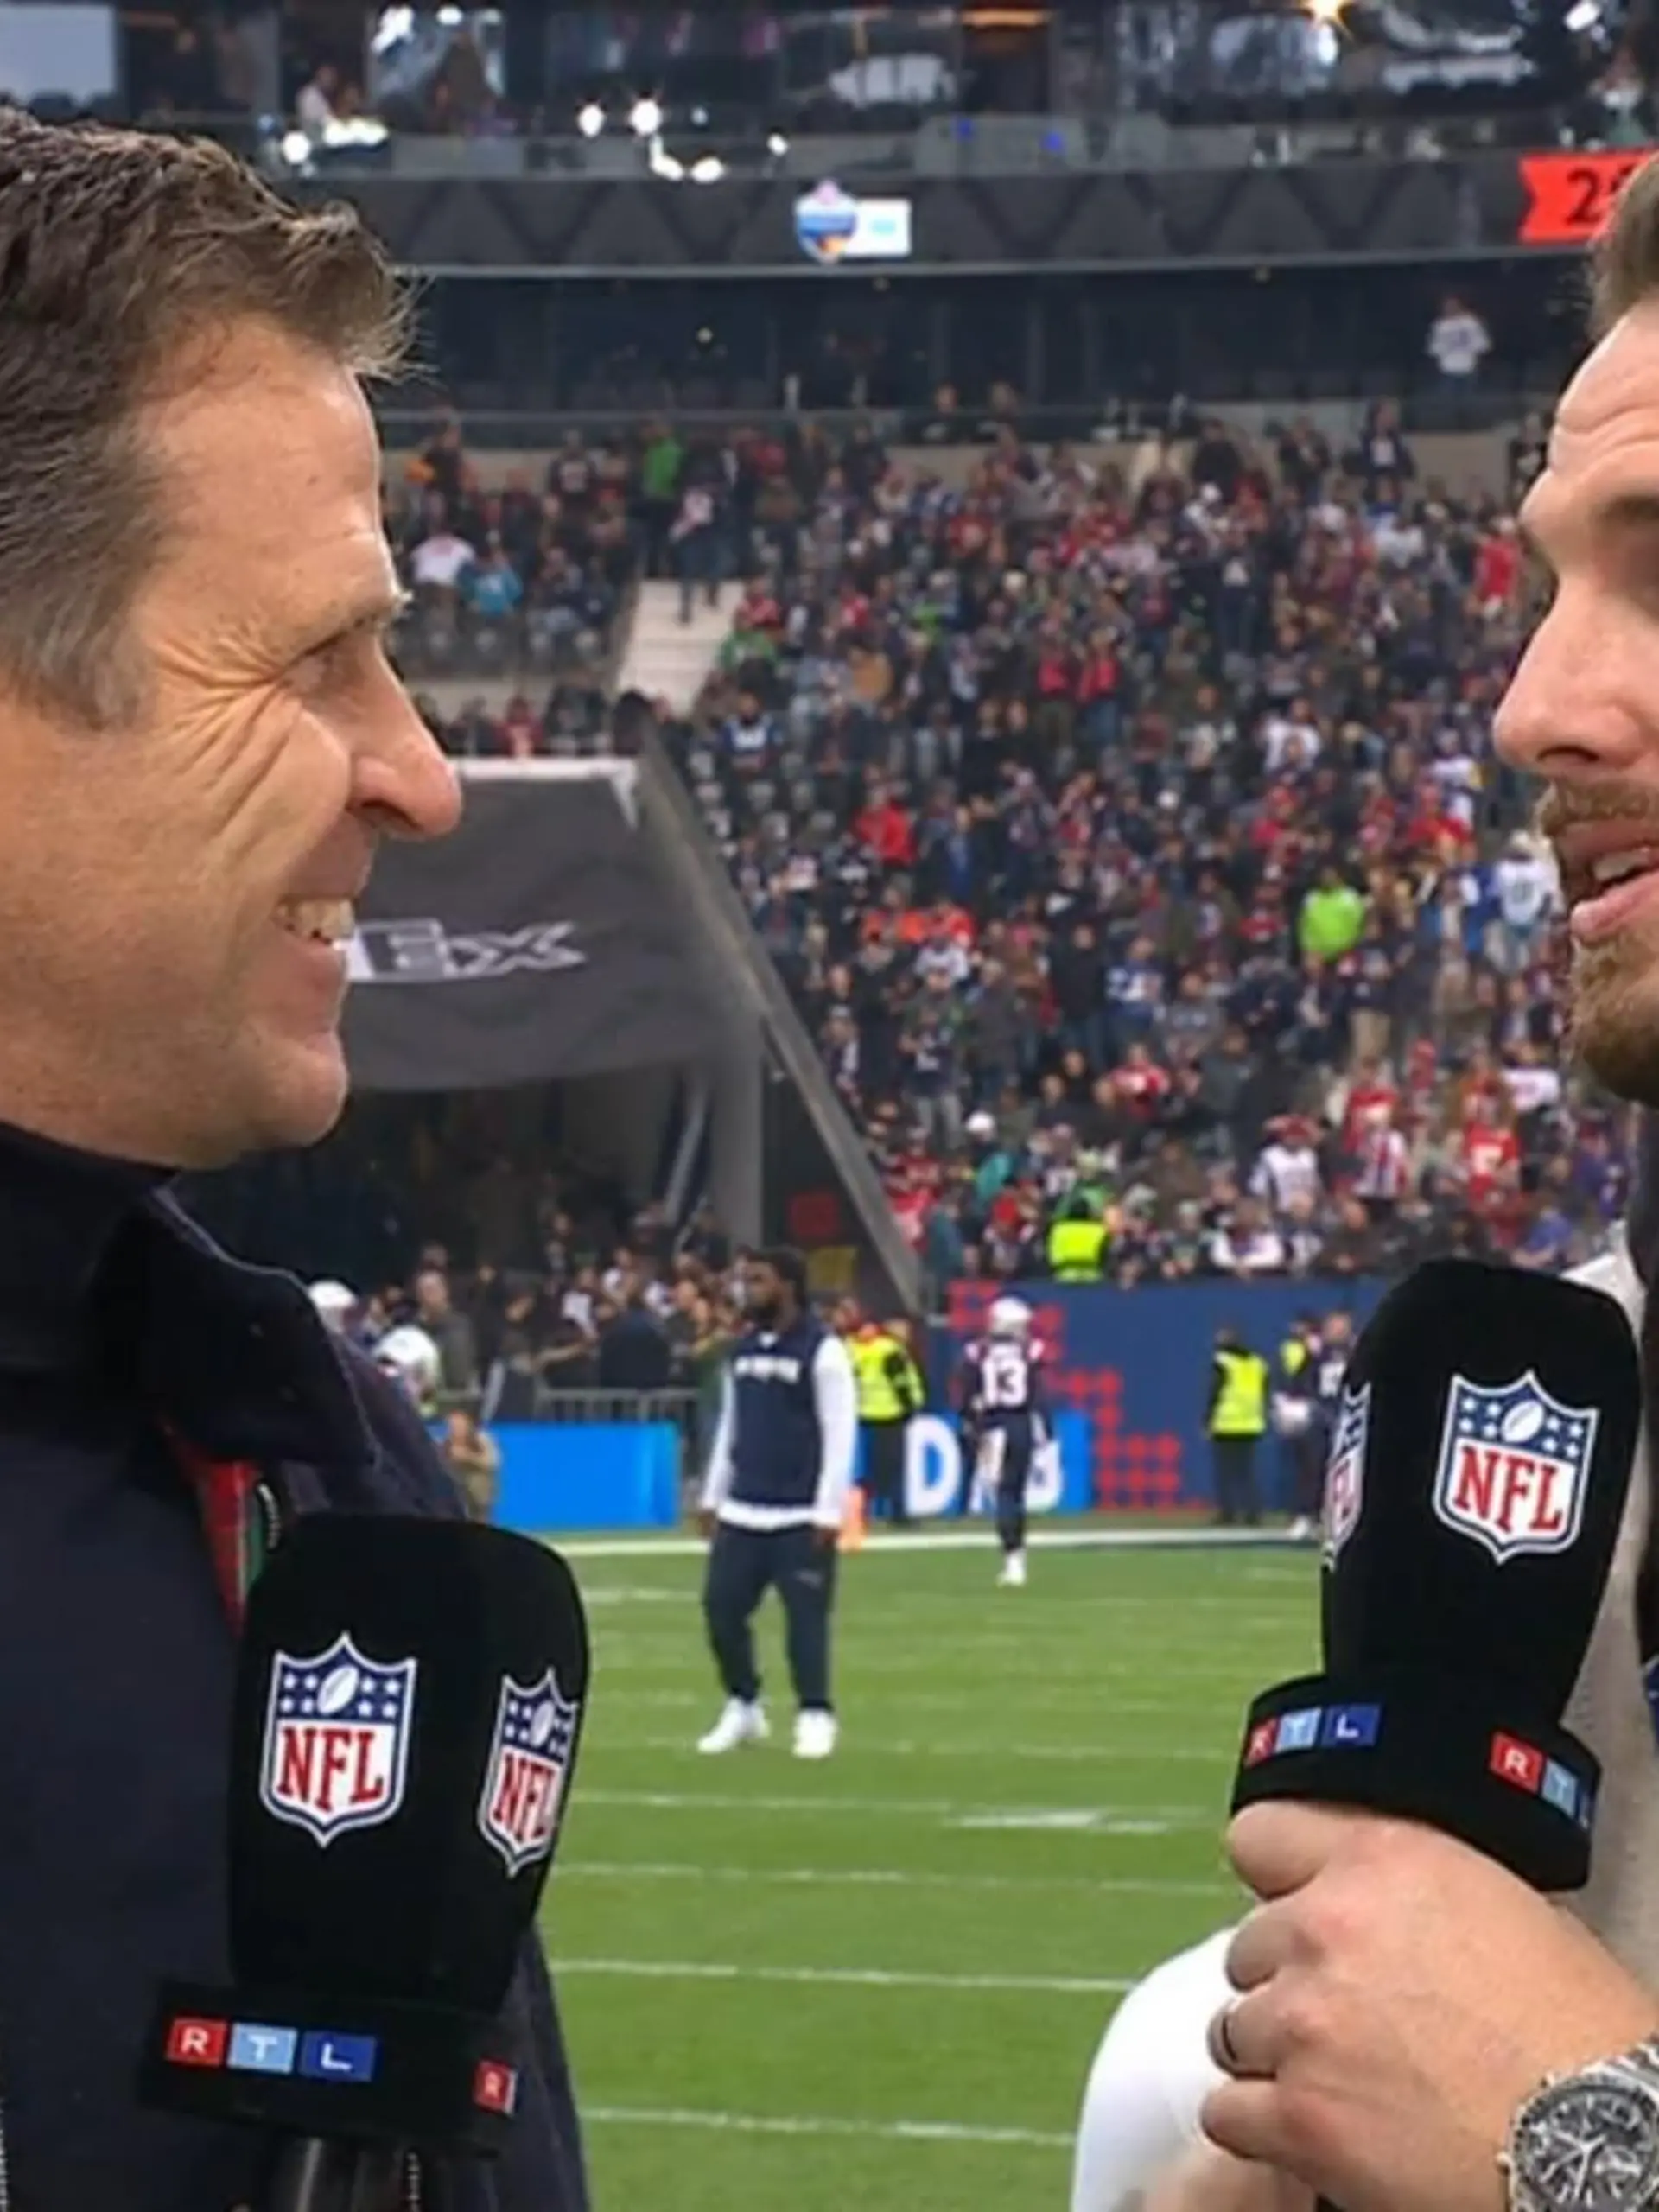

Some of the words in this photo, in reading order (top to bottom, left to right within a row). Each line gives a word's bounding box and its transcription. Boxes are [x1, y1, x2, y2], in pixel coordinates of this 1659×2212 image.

[982, 1358, 1029, 1408] 13
[1452, 1446, 1562, 1534] NFL
[277, 1726, 384, 1812] NFL
[493, 1752, 554, 1844] NFL
[178, 2024, 354, 2072] RTL
